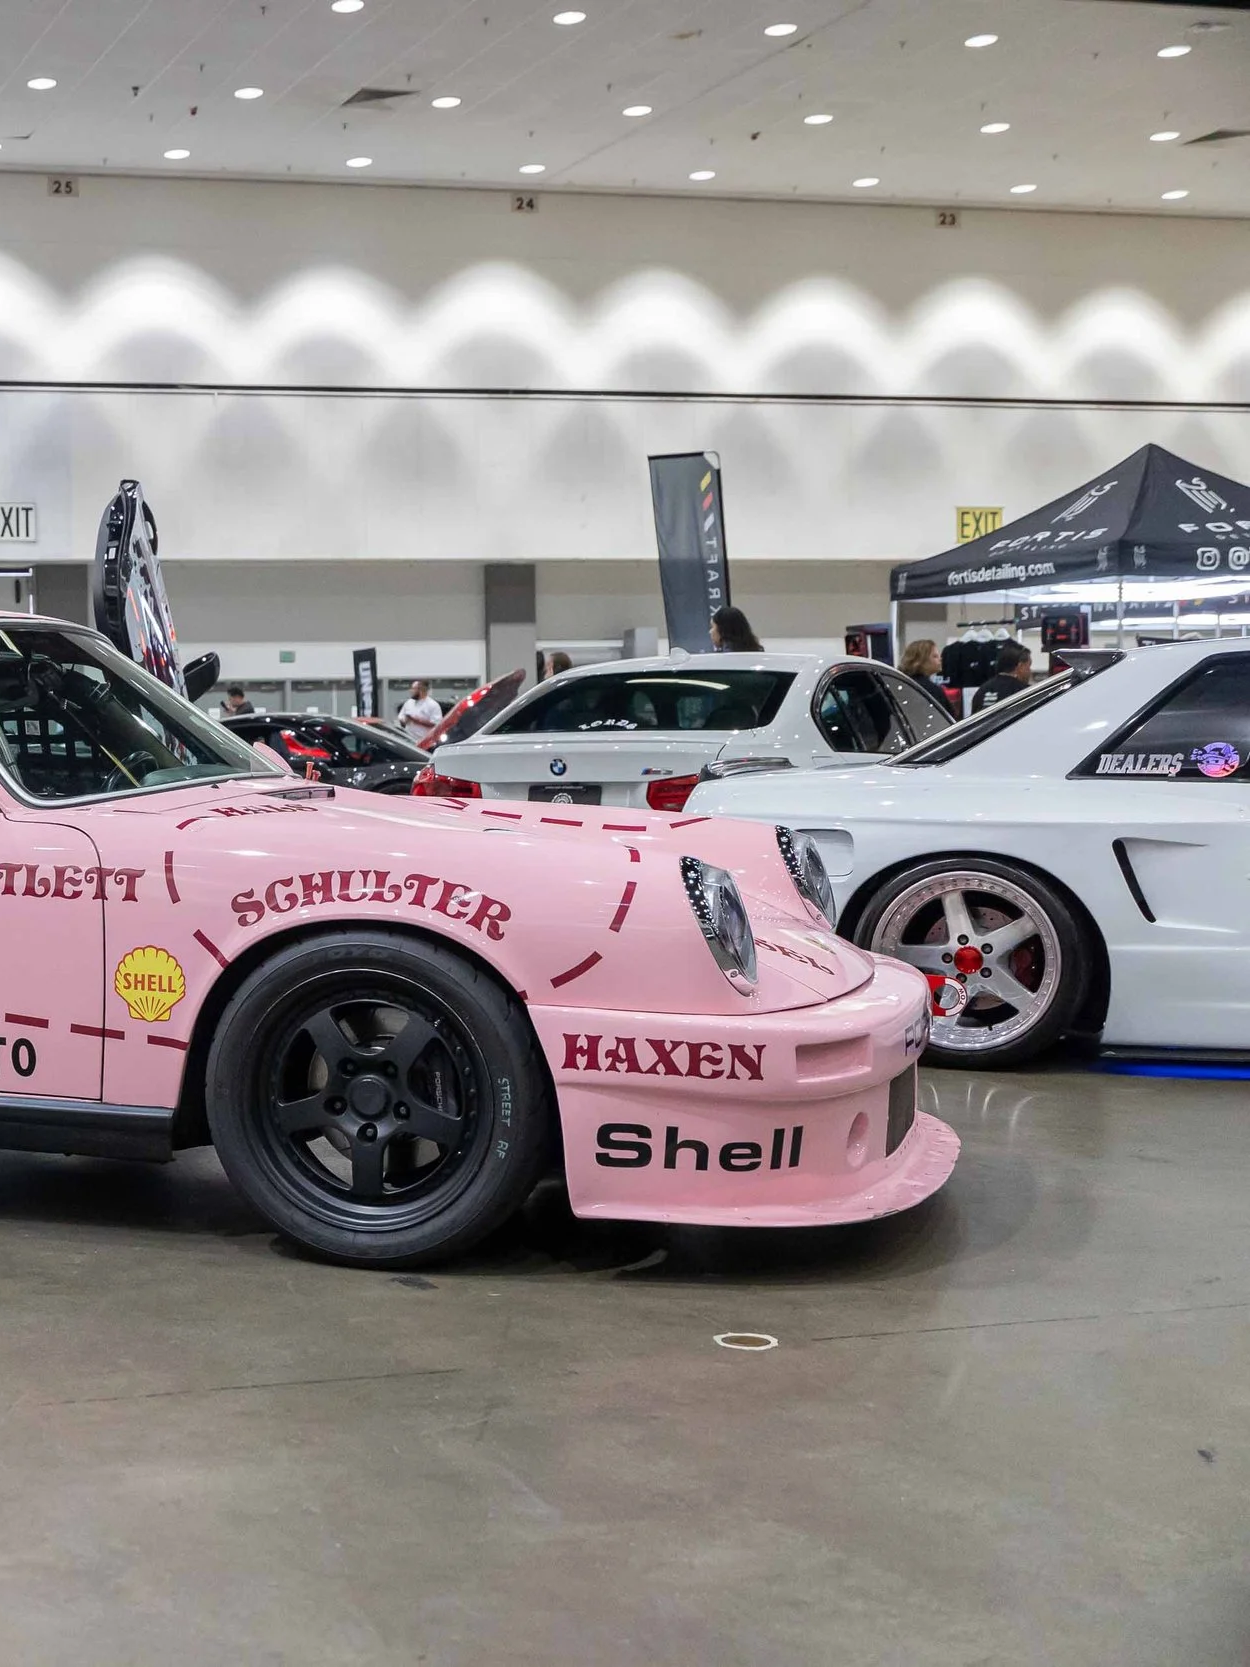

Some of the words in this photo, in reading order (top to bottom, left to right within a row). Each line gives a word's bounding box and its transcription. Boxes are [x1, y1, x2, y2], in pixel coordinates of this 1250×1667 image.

[52, 180, 73, 194] 25
[516, 197, 534, 210] 24
[939, 212, 956, 225] 23
[960, 511, 998, 539] EXIT
[989, 528, 1108, 551] FORTIS
[947, 562, 1056, 587] fortisdetailing.com
[1095, 752, 1184, 777] DEALERS
[230, 869, 512, 942] SCHULTER
[122, 972, 177, 993] SHELL
[958, 988, 966, 1006] TOW
[561, 1033, 766, 1081] HAXEN
[497, 1077, 511, 1127] STREET
[496, 1140, 508, 1159] RF
[595, 1123, 804, 1172] Shell
